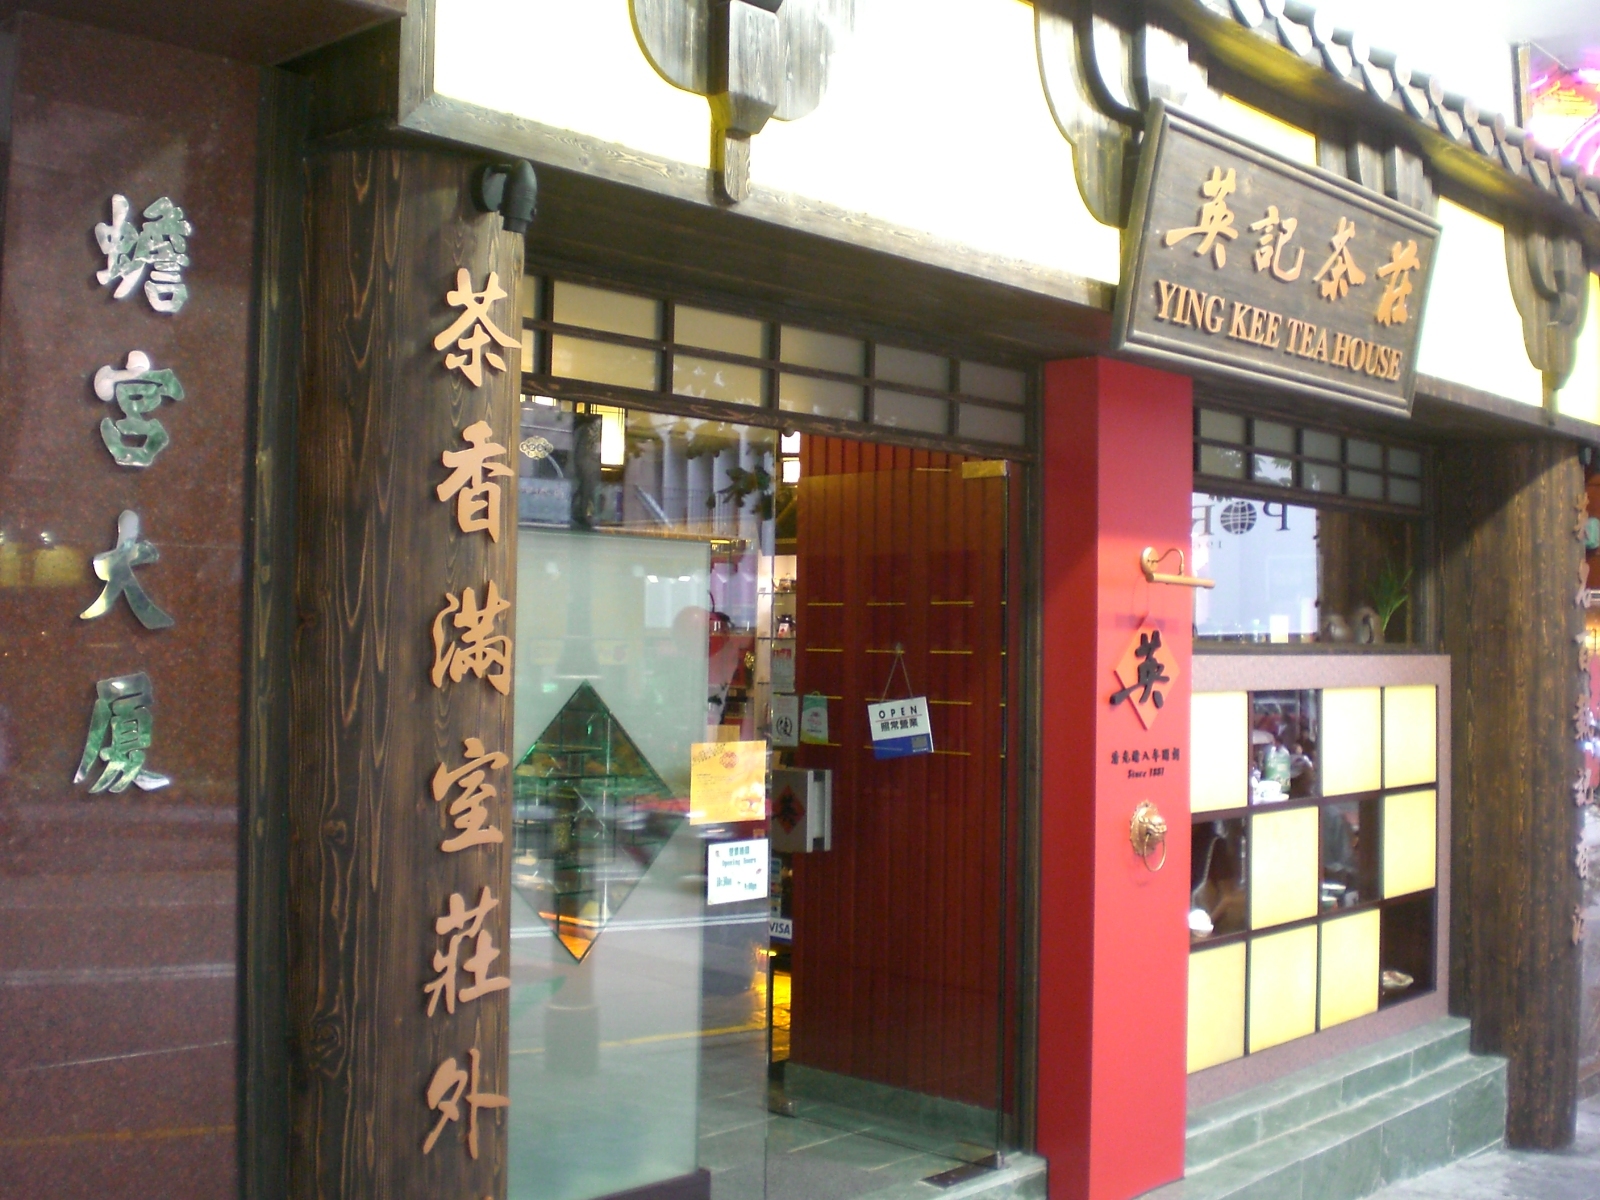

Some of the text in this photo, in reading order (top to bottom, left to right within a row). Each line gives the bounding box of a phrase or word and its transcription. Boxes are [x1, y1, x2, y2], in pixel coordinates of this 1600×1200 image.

[1156, 279, 1403, 383] YING KEE TEA HOUSE
[1109, 630, 1170, 709] 英
[878, 705, 918, 719] OPEN
[1127, 769, 1147, 779] Since
[769, 922, 791, 935] VISA
